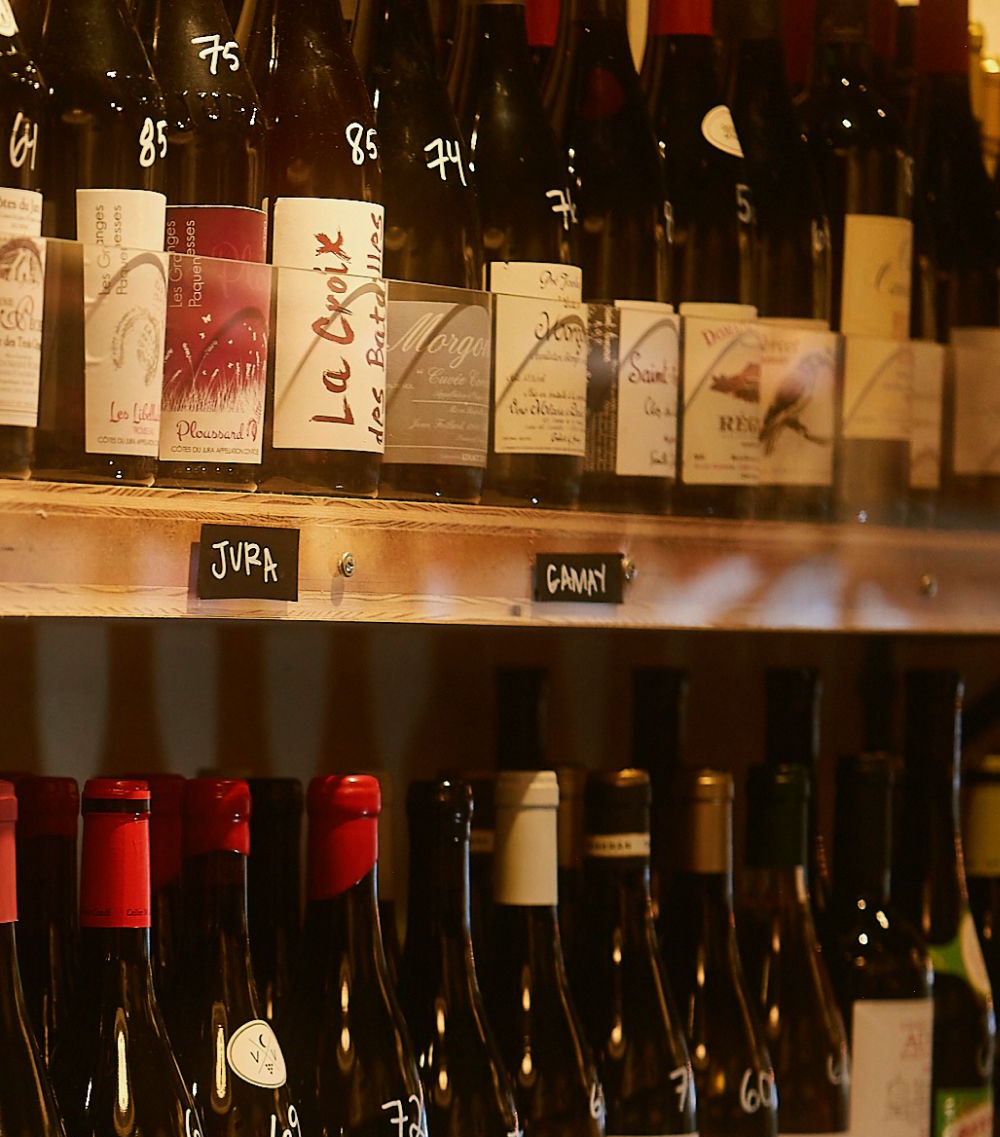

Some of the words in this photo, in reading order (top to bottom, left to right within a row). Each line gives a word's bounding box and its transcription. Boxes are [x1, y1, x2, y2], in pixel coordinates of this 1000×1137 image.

[191, 34, 240, 74] 75
[139, 116, 168, 168] 85
[345, 121, 379, 166] 85
[309, 356, 355, 425] La
[211, 540, 279, 583] JURA
